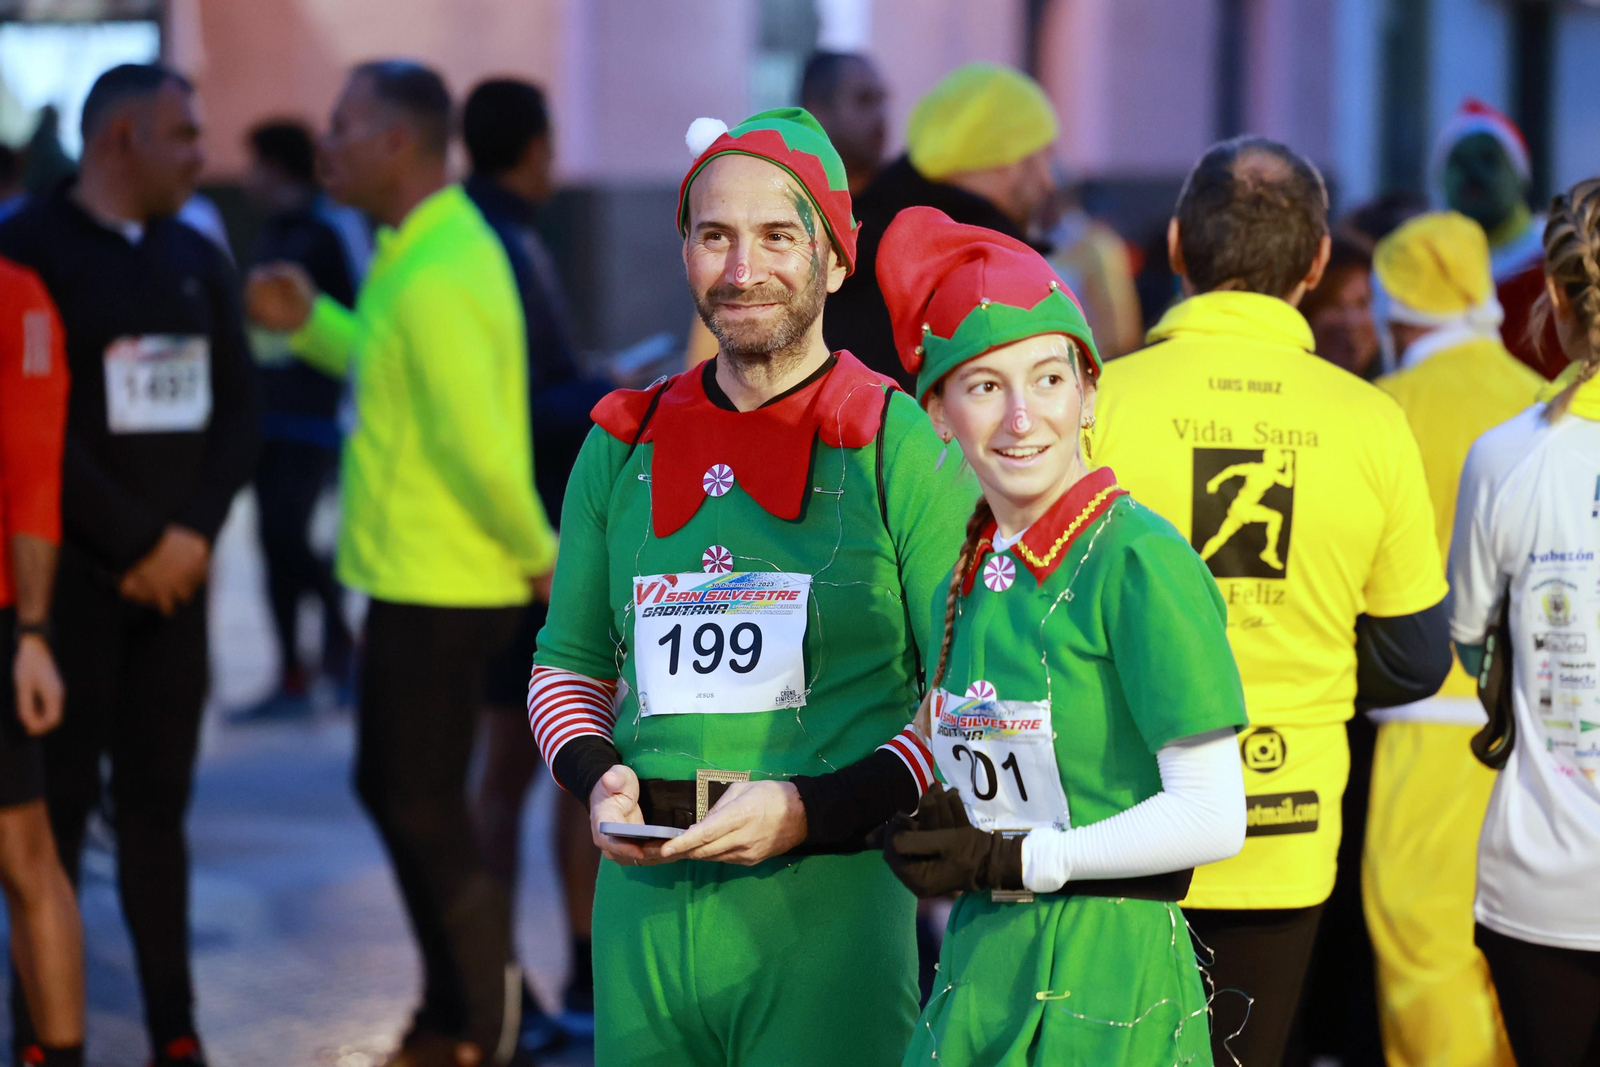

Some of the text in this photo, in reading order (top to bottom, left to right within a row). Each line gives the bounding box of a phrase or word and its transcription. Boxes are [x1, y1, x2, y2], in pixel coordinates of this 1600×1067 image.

[1208, 377, 1283, 394] LUIS RUIZ
[1171, 418, 1320, 447] Vida Sana
[636, 583, 802, 605] VI SAN SILVESTRE
[1228, 584, 1286, 605] Feliz
[642, 604, 729, 618] GADITANA
[658, 622, 763, 676] 199
[695, 691, 715, 699] JESÚS
[943, 712, 957, 726] SAN
[959, 716, 1043, 730] SILVESTRE
[952, 744, 1028, 802] 201
[1247, 797, 1318, 827] otmail.com
